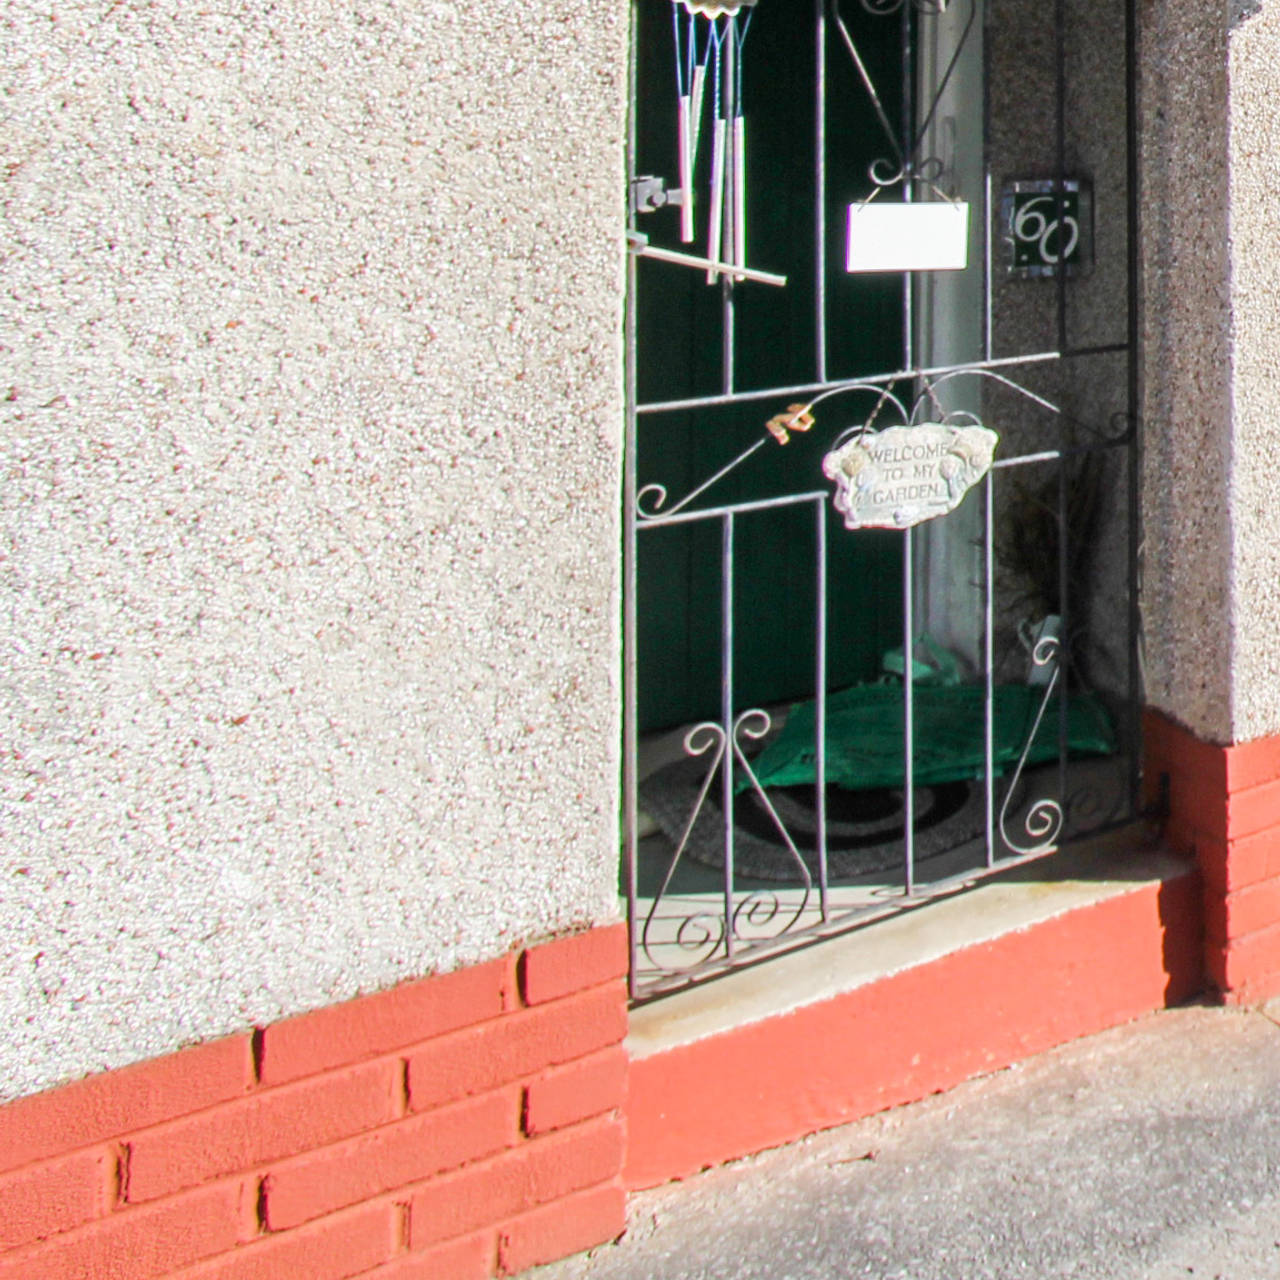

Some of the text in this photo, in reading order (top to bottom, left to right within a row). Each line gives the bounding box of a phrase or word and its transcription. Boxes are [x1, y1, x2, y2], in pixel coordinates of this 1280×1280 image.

[1015, 196, 1079, 263] 60
[868, 442, 950, 463] WELCOME
[884, 463, 936, 482] TO MY
[873, 483, 939, 505] GARDEN
